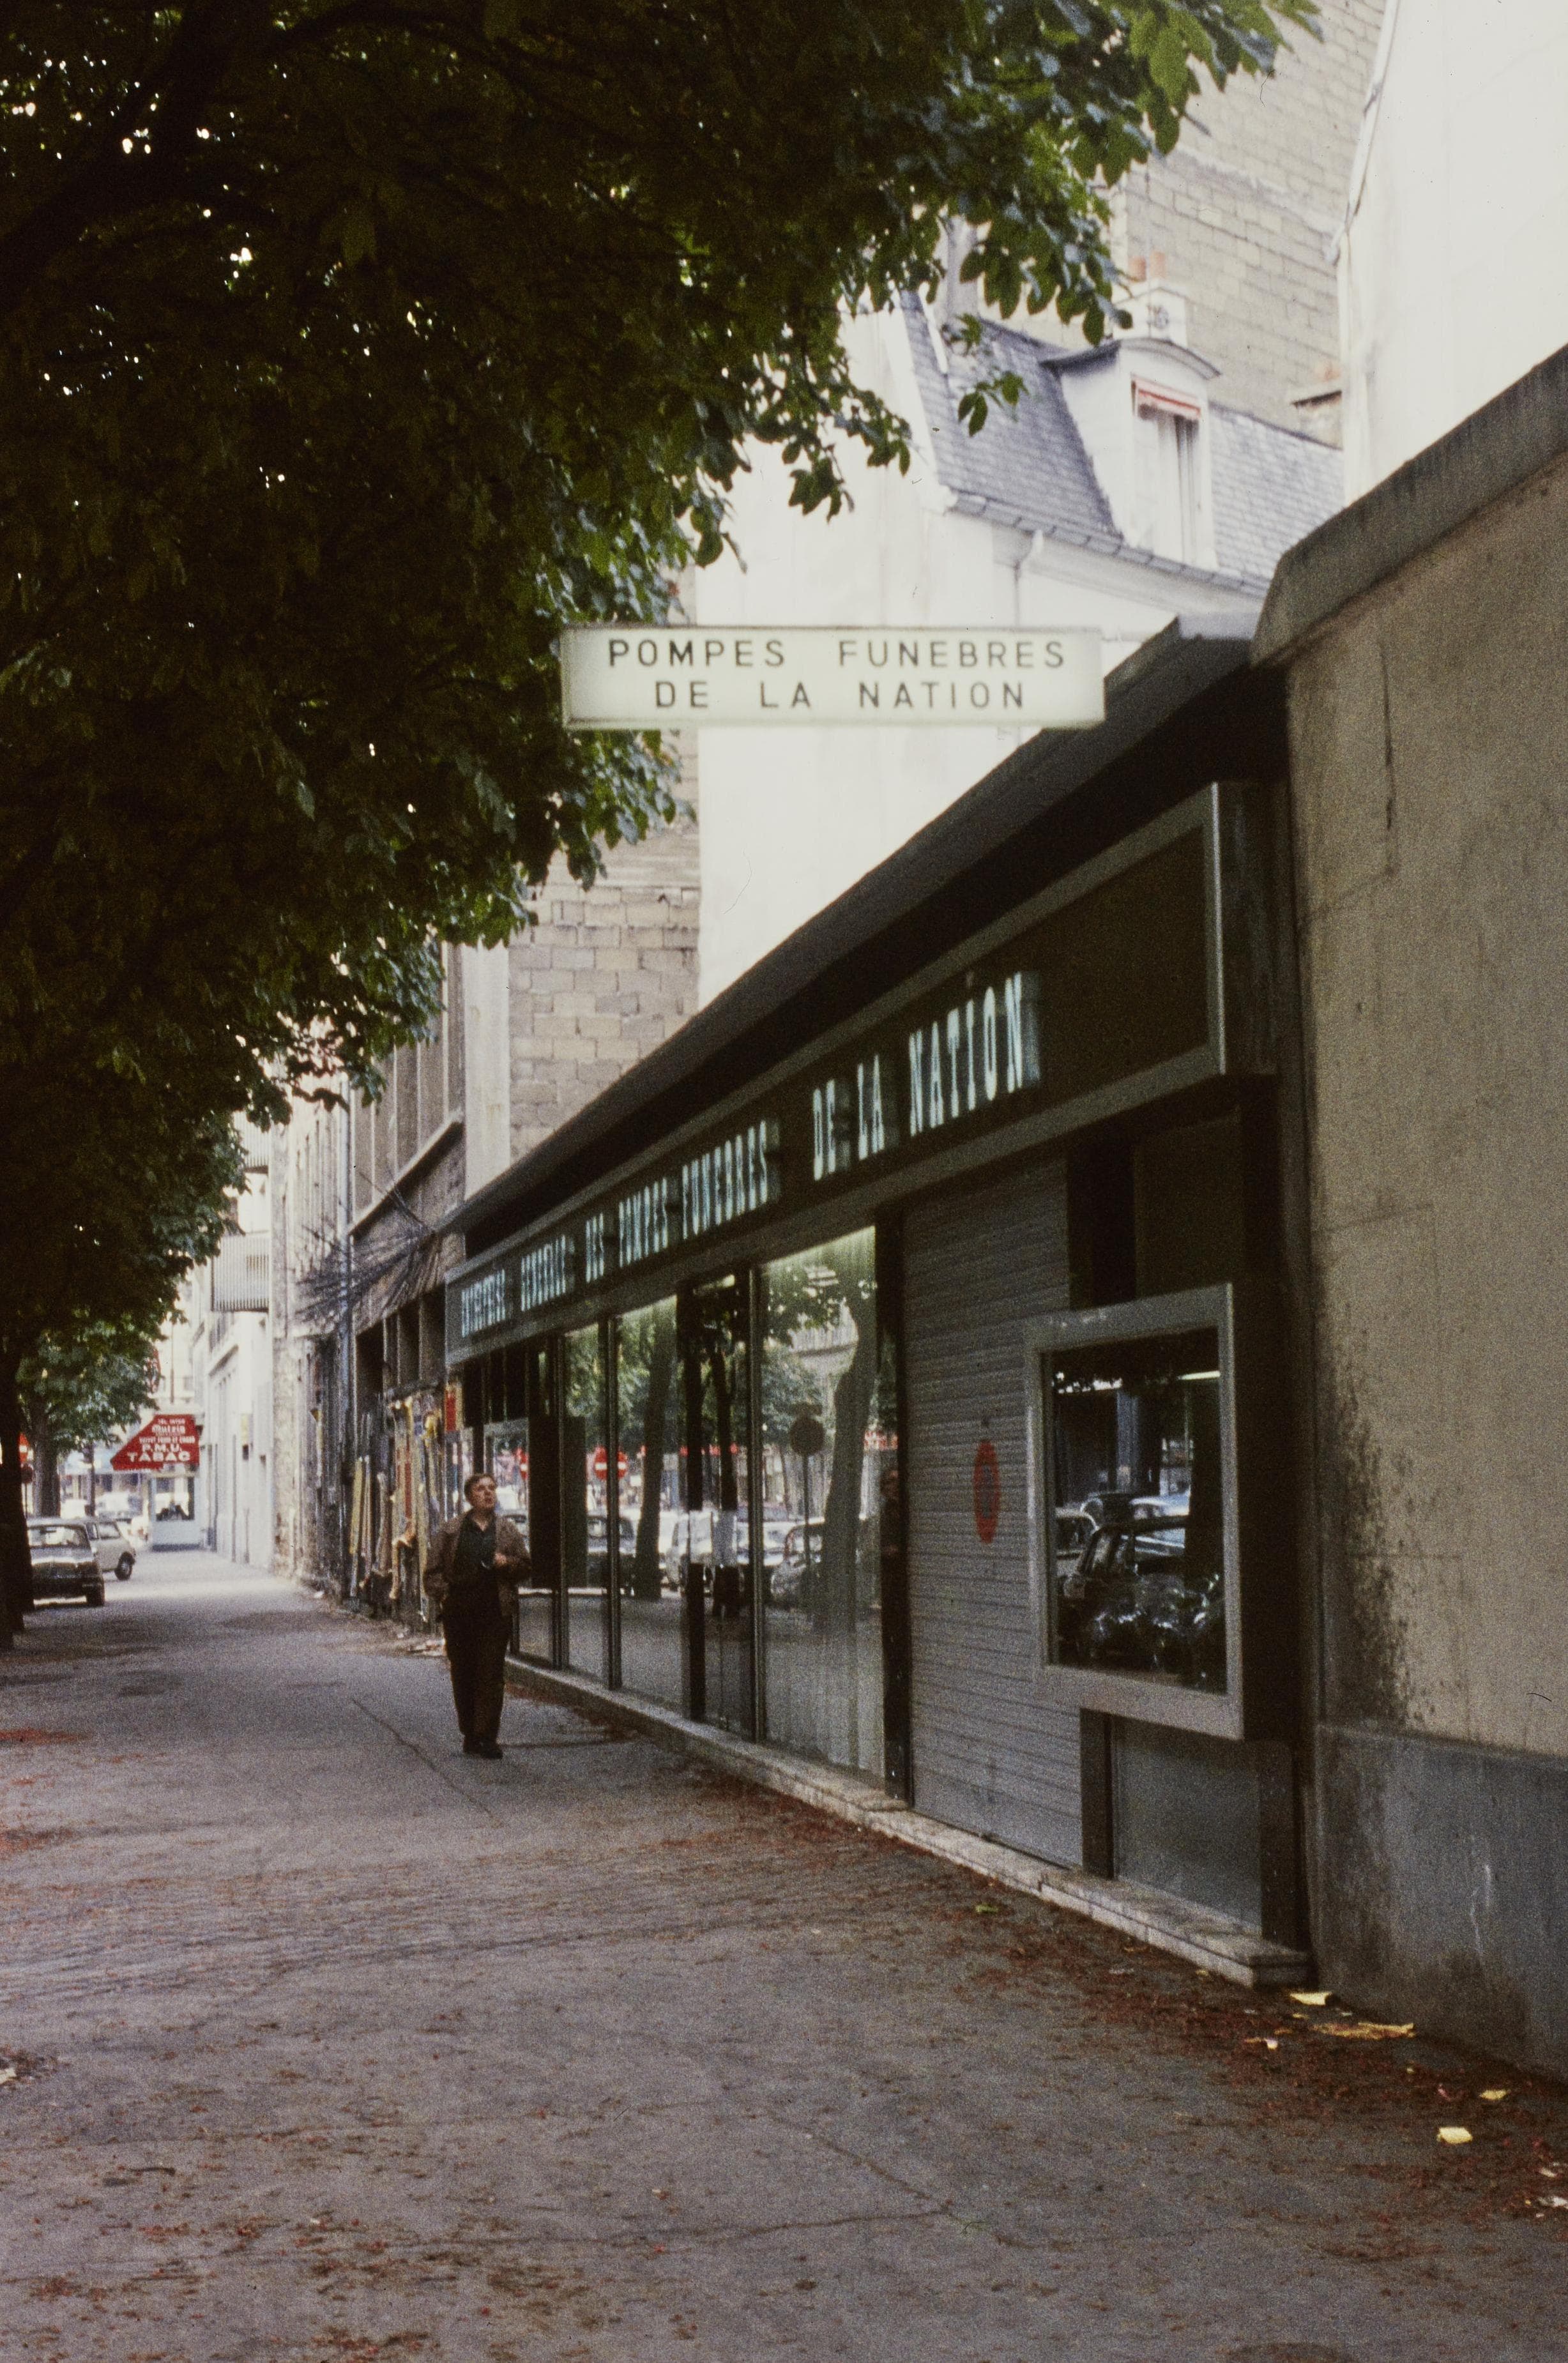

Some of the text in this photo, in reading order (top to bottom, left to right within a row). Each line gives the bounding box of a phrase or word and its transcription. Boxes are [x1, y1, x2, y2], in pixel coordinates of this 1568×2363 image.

[609, 639, 1065, 669] POMPES FUNEBRES
[655, 681, 1024, 708] DE LA NATION
[618, 1177, 669, 1268] POMPES
[681, 1120, 769, 1240] FUNEBRES
[812, 1078, 837, 1182] DE
[857, 1054, 886, 1160] LA
[909, 972, 1023, 1137] NATION
[127, 1451, 191, 1462] TABAC
[142, 1443, 182, 1452] P.M.U.
